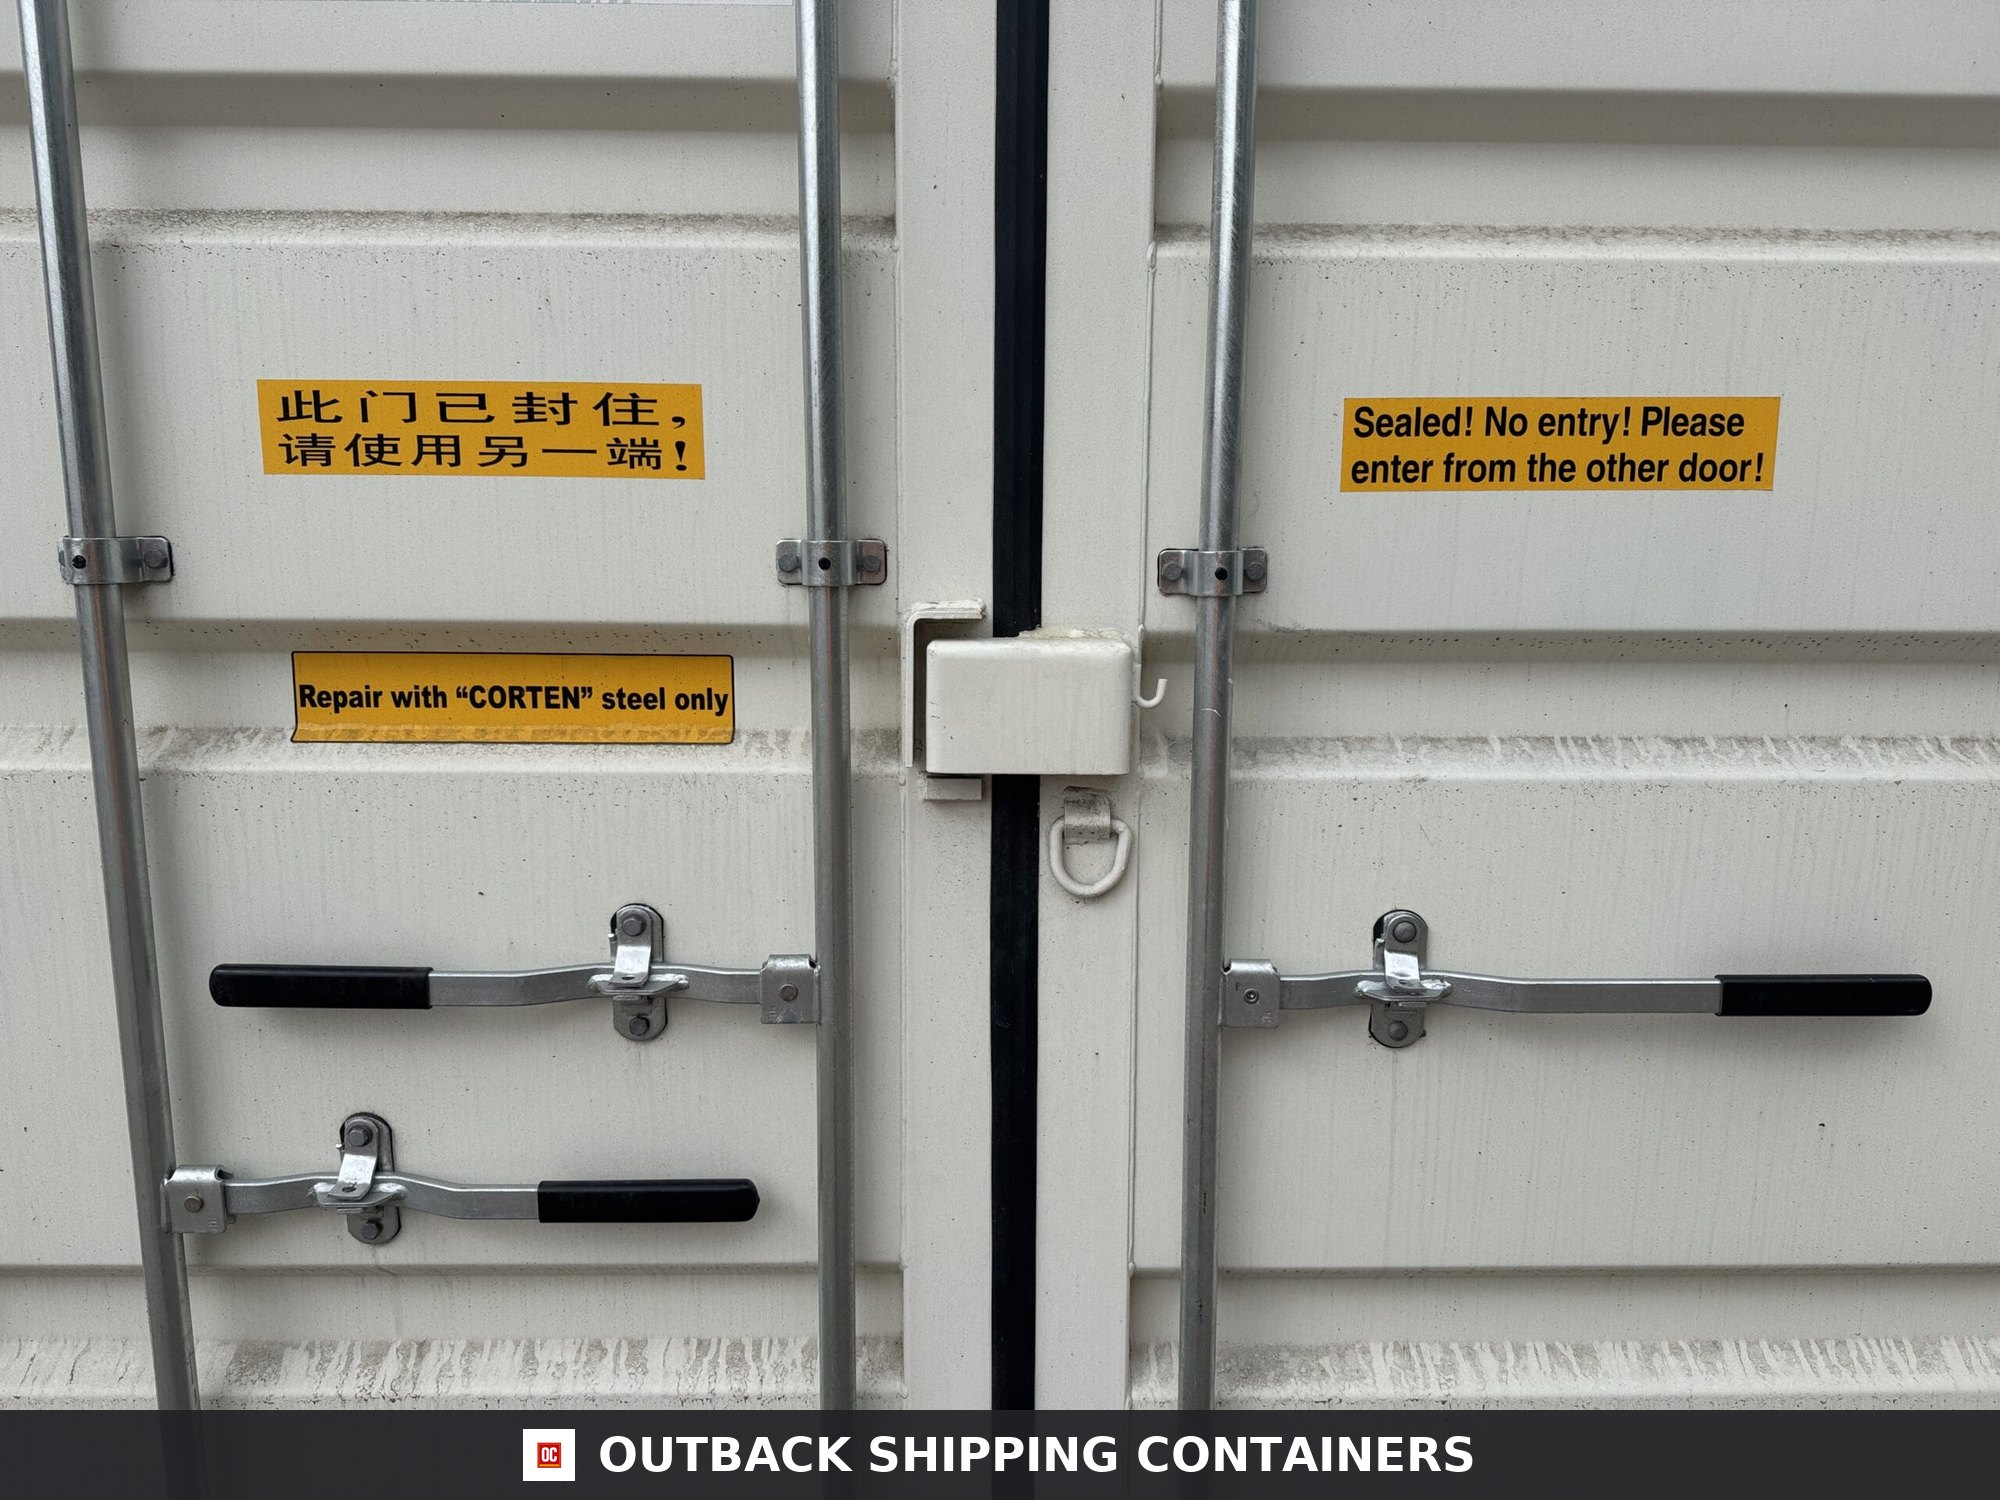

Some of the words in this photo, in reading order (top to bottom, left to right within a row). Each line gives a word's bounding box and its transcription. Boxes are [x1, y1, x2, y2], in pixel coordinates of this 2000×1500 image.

[1354, 406, 1472, 438] Sealed!
[1485, 406, 1527, 436] No
[1538, 407, 1630, 444] entry!
[1641, 406, 1744, 436] Please
[1352, 455, 1433, 484] enter
[1443, 452, 1515, 482] from
[1527, 453, 1576, 482] the
[1587, 453, 1669, 482] other
[1679, 452, 1764, 482] door!
[299, 685, 383, 713] Repair
[391, 685, 447, 708] with
[456, 685, 592, 709] “CORTEN”
[602, 687, 665, 710] steel
[675, 688, 728, 716] only
